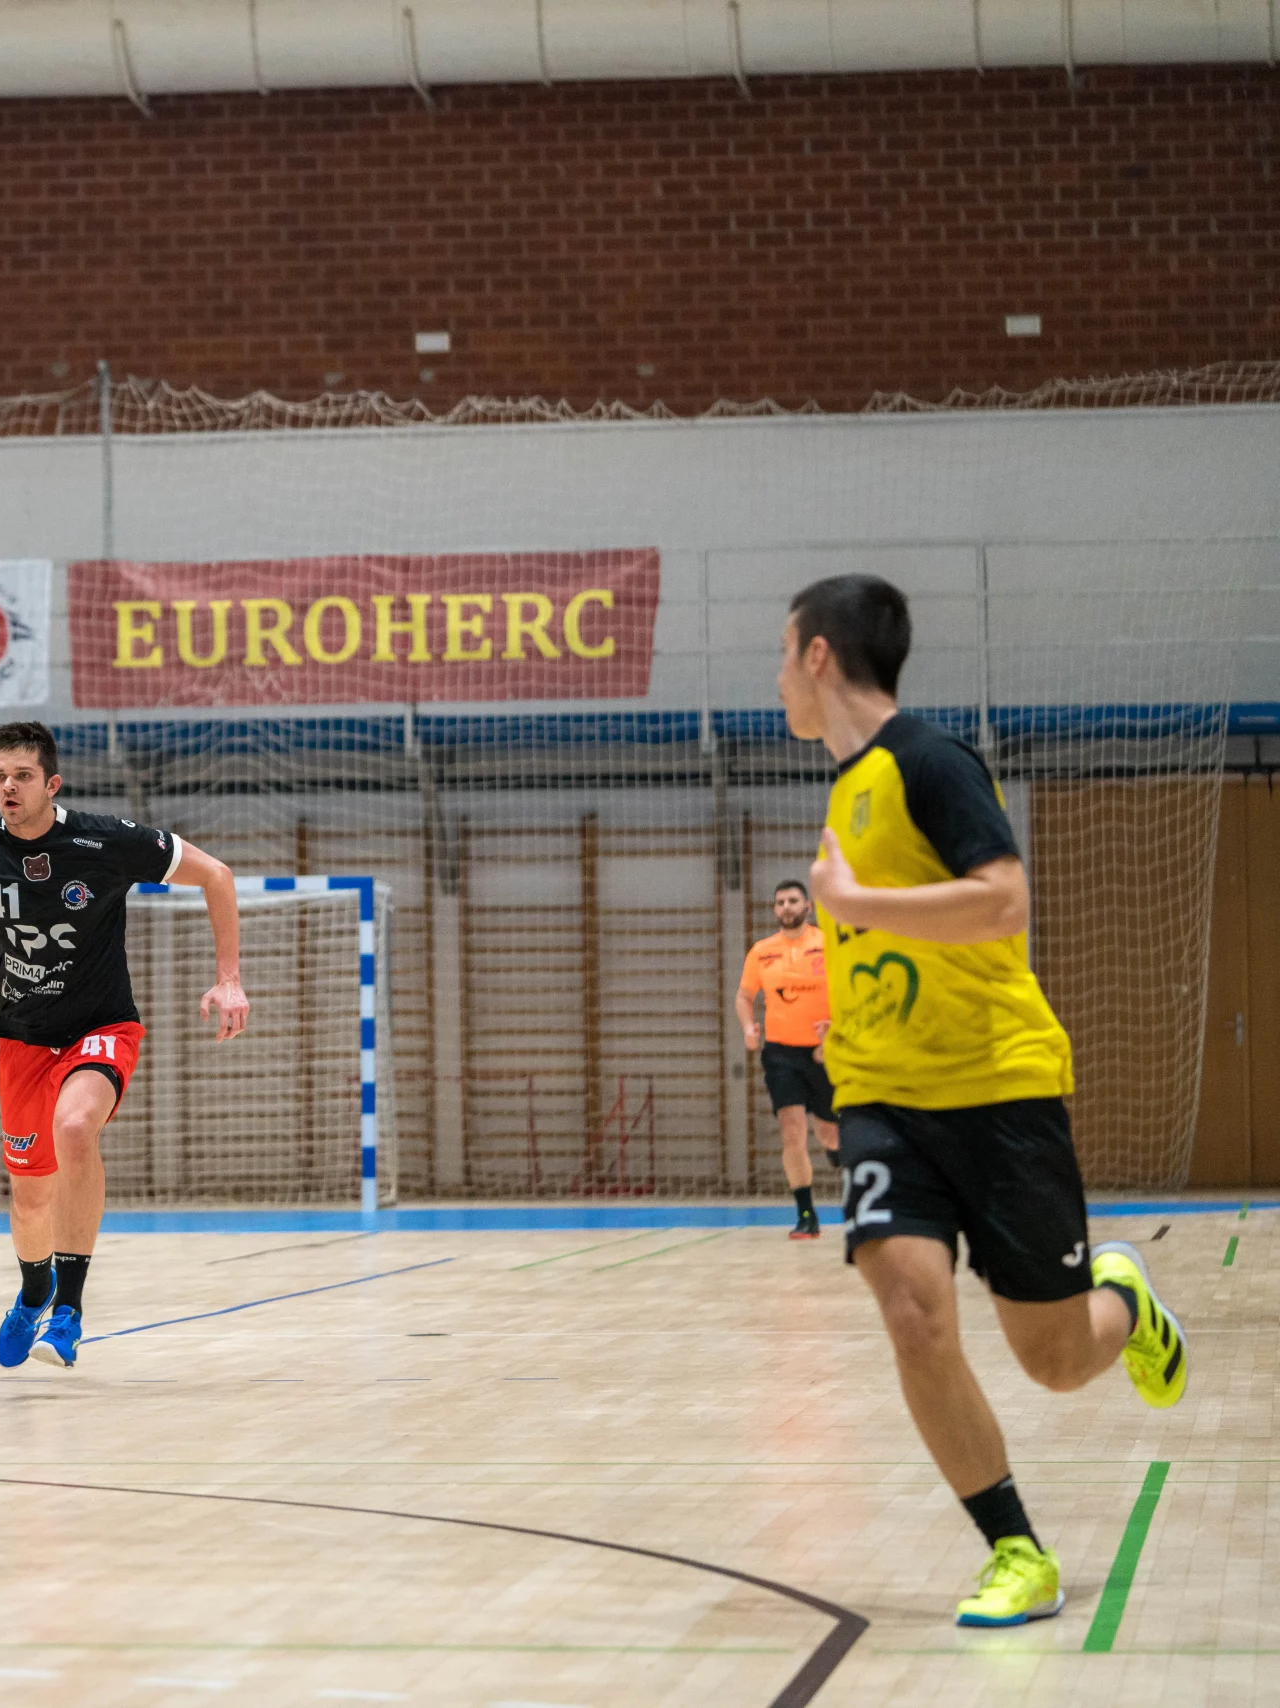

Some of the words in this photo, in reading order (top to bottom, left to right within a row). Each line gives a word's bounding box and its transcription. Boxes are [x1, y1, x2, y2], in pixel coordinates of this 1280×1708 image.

[112, 589, 616, 668] EUROHERC
[6, 957, 41, 979] PRIMA
[80, 1035, 116, 1060] 41
